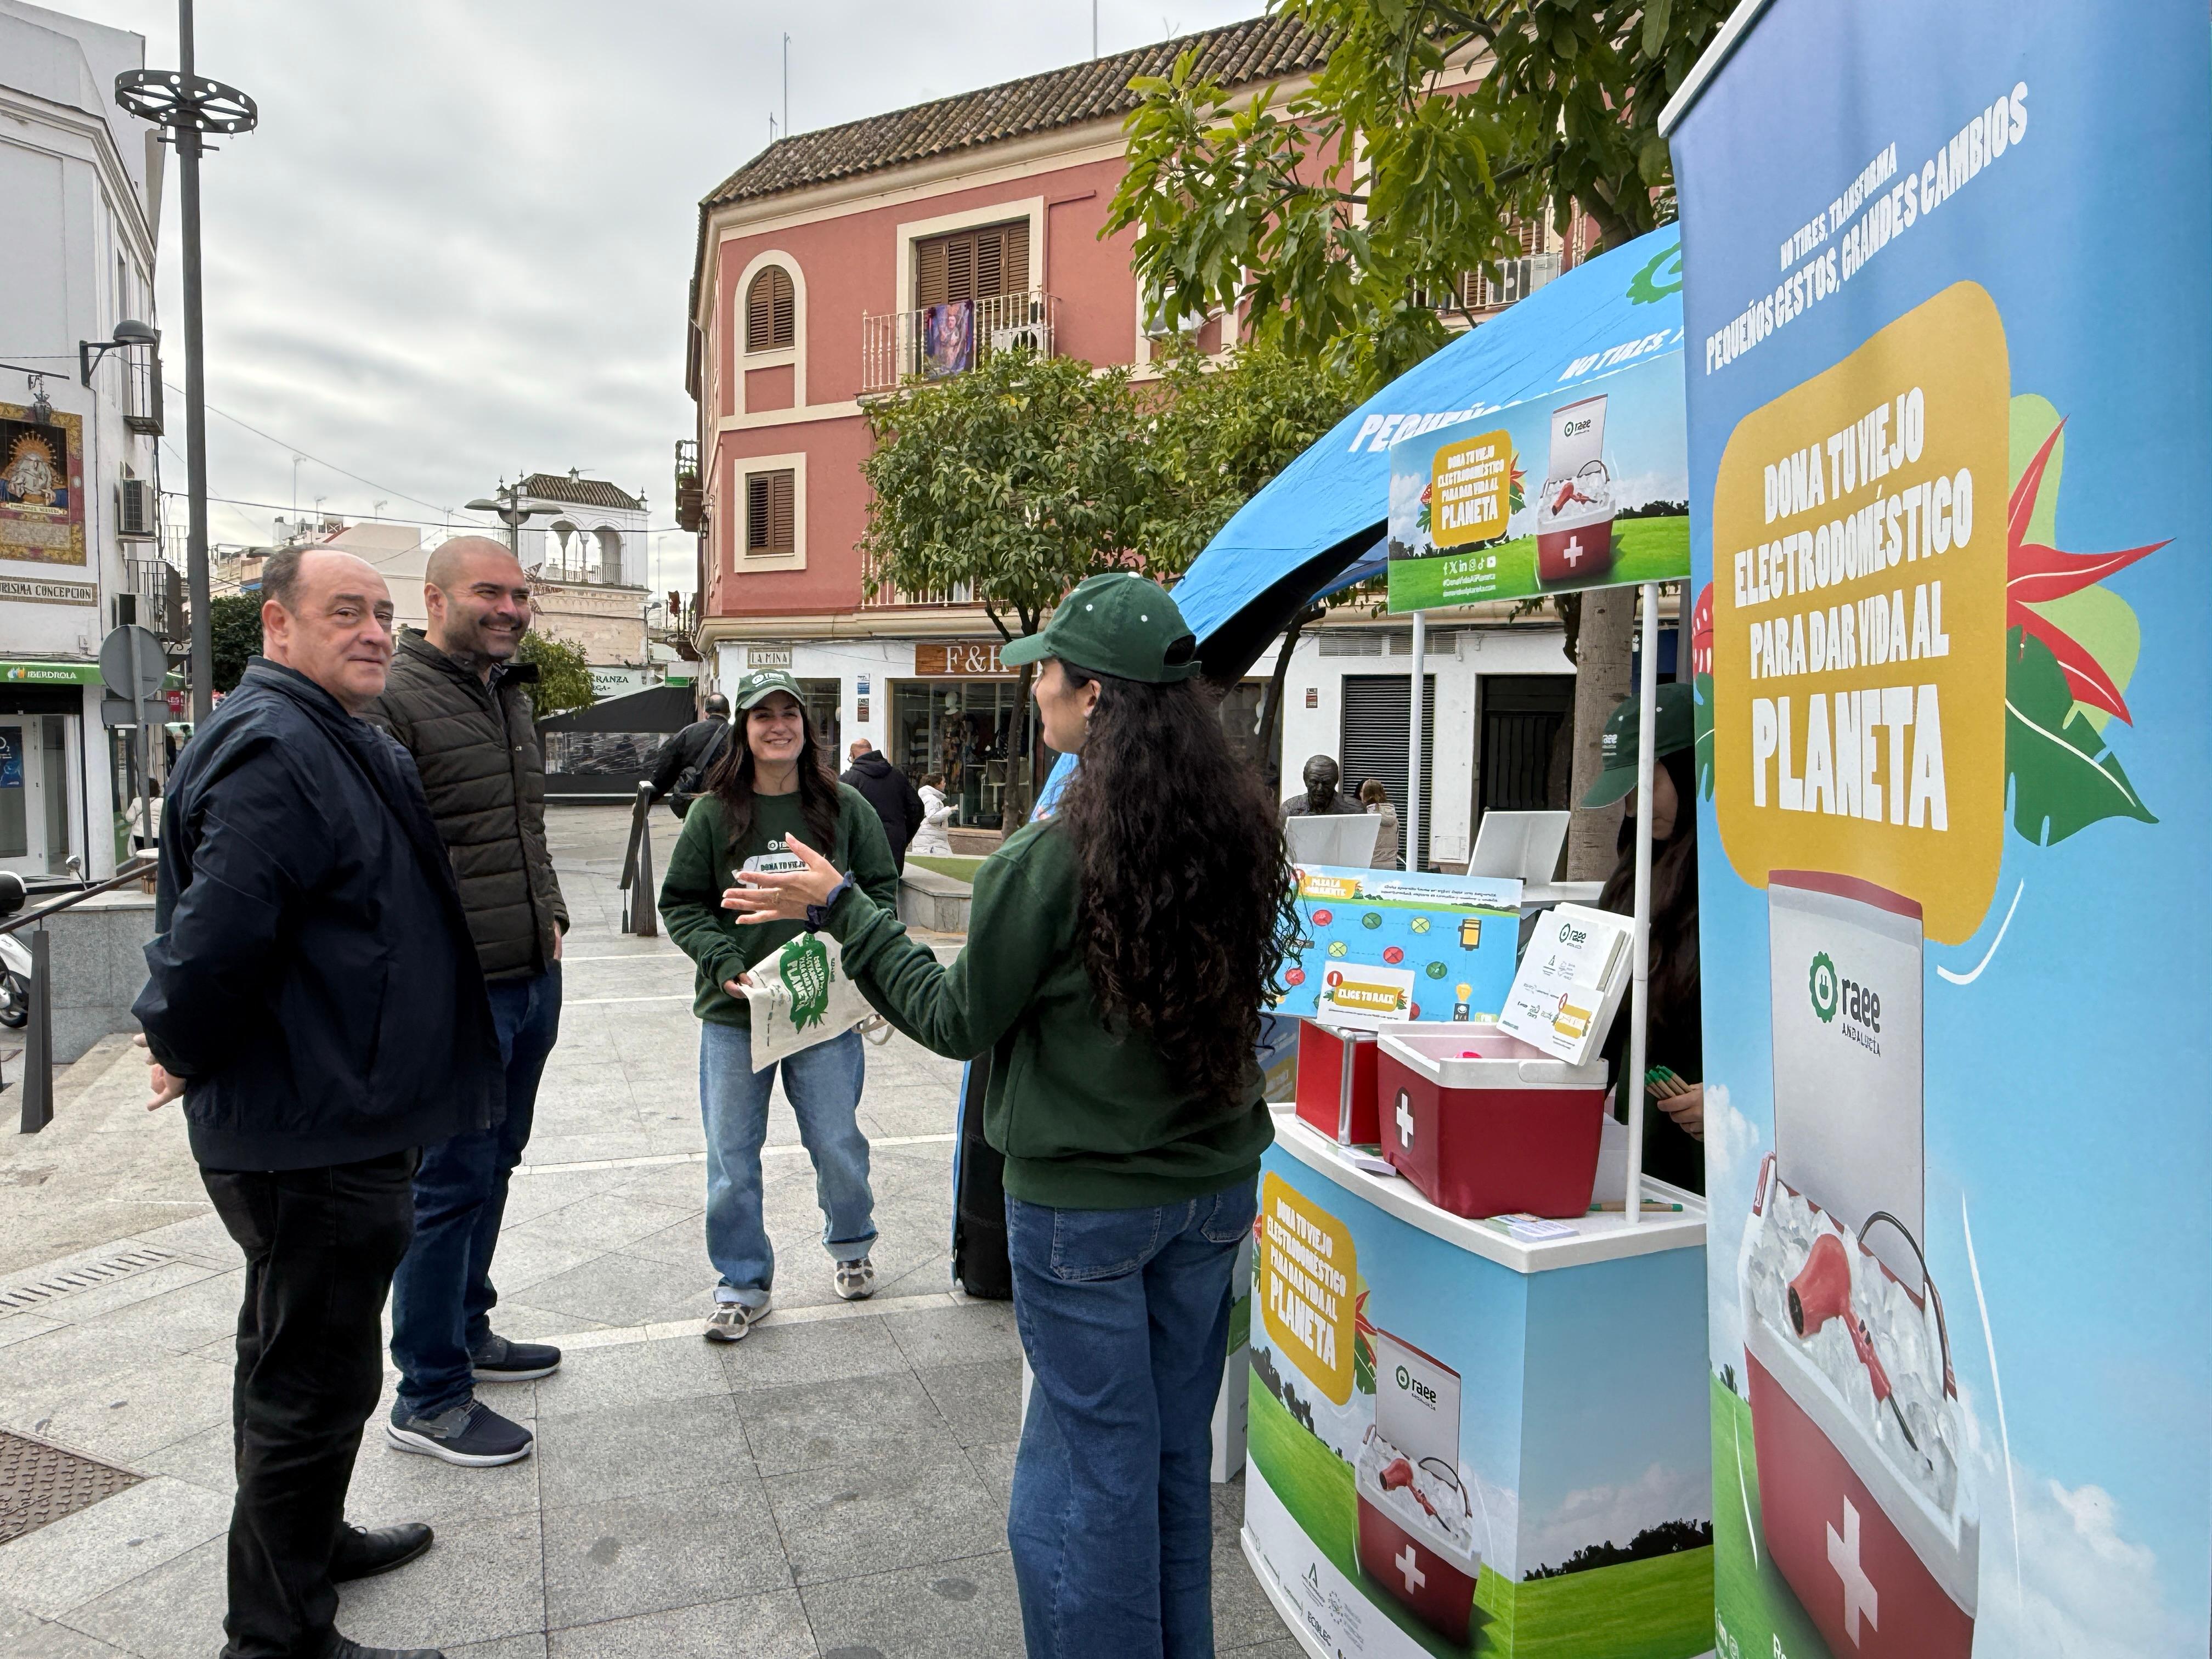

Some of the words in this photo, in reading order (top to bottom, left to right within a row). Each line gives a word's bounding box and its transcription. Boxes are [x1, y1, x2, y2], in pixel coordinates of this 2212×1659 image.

[1706, 294, 1774, 376] PEQUEÑOS
[1775, 247, 1840, 328] GESTOS,
[1842, 173, 1918, 281] GRANDES
[1921, 81, 2028, 215] CAMBIOS
[1781, 238, 1793, 272] NO
[1793, 212, 1828, 260] TIRES,
[1829, 141, 1897, 233] TRANSFORMA
[1558, 353, 1600, 382] NO
[1764, 443, 1825, 524] DONA
[1827, 424, 1856, 500] TU
[1858, 387, 1925, 487] VIEJO
[1442, 494, 1498, 530] PLANETA
[1735, 468, 1973, 608] ELECTRODOMÉSTICO
[1750, 613, 1807, 679] PARA
[1809, 603, 1856, 673] DAR
[1858, 589, 1908, 666] VIDA
[1911, 580, 1949, 659] AL
[1752, 684, 1948, 832] PLANETA
[1842, 979, 1880, 1033] raee
[1277, 1197, 1295, 1231] DONA
[1307, 1222, 1333, 1259] VIEJO
[1271, 1270, 1336, 1372] PLANETA
[1325, 1294, 1338, 1322] AL
[1412, 1379, 1436, 1403] raee
